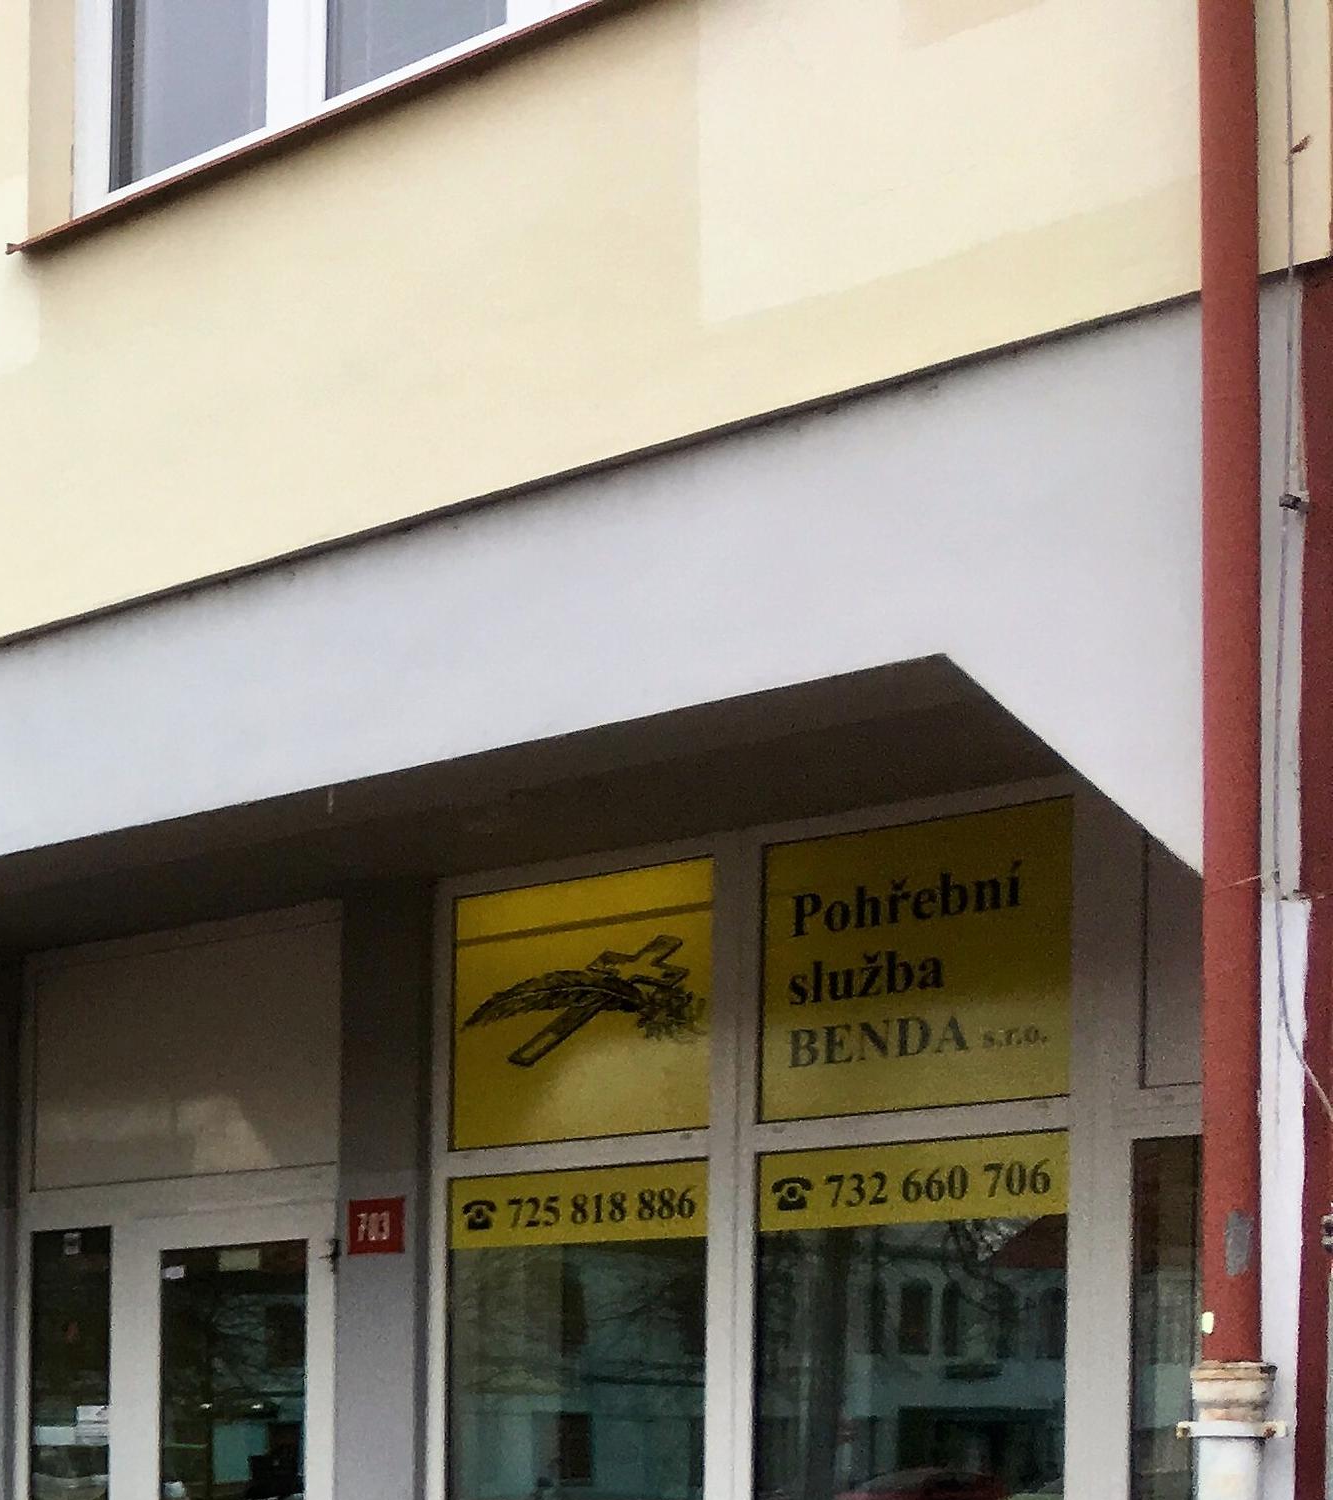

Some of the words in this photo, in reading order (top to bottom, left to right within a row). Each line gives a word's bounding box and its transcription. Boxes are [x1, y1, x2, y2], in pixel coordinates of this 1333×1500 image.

[789, 859, 1024, 938] Pohřební
[788, 951, 945, 1006] služba
[788, 1015, 969, 1069] BENDA
[983, 1024, 1048, 1050] s.r.o.
[507, 1195, 561, 1229] 725
[570, 1191, 627, 1225] 818
[636, 1185, 698, 1222] 886
[825, 1170, 889, 1208] 732
[901, 1164, 970, 1203] 660
[983, 1158, 1052, 1198] 706
